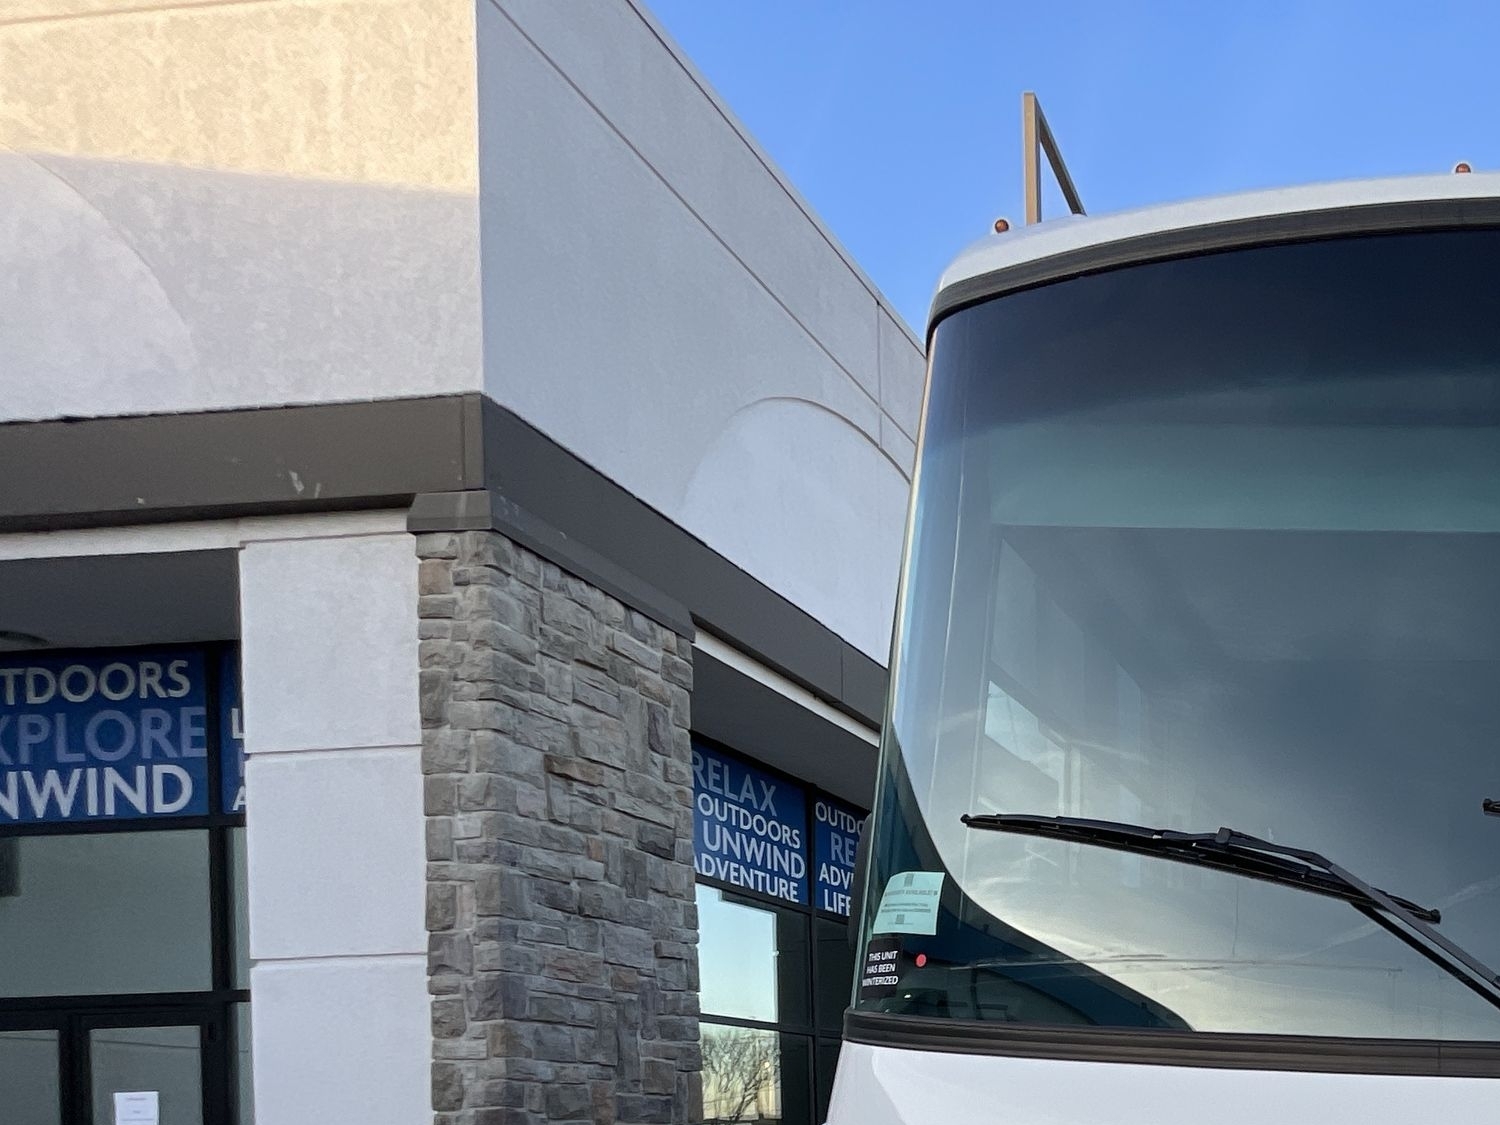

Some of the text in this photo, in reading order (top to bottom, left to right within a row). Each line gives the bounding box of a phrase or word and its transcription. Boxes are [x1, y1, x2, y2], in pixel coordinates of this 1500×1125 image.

[698, 793, 801, 849] OUTDOORS
[703, 820, 806, 879] UNWIND
[819, 862, 854, 890] ADV
[869, 950, 898, 961] THIS UNIT
[867, 963, 896, 973] HAS BEEN
[862, 975, 899, 987] WINTERIZED
